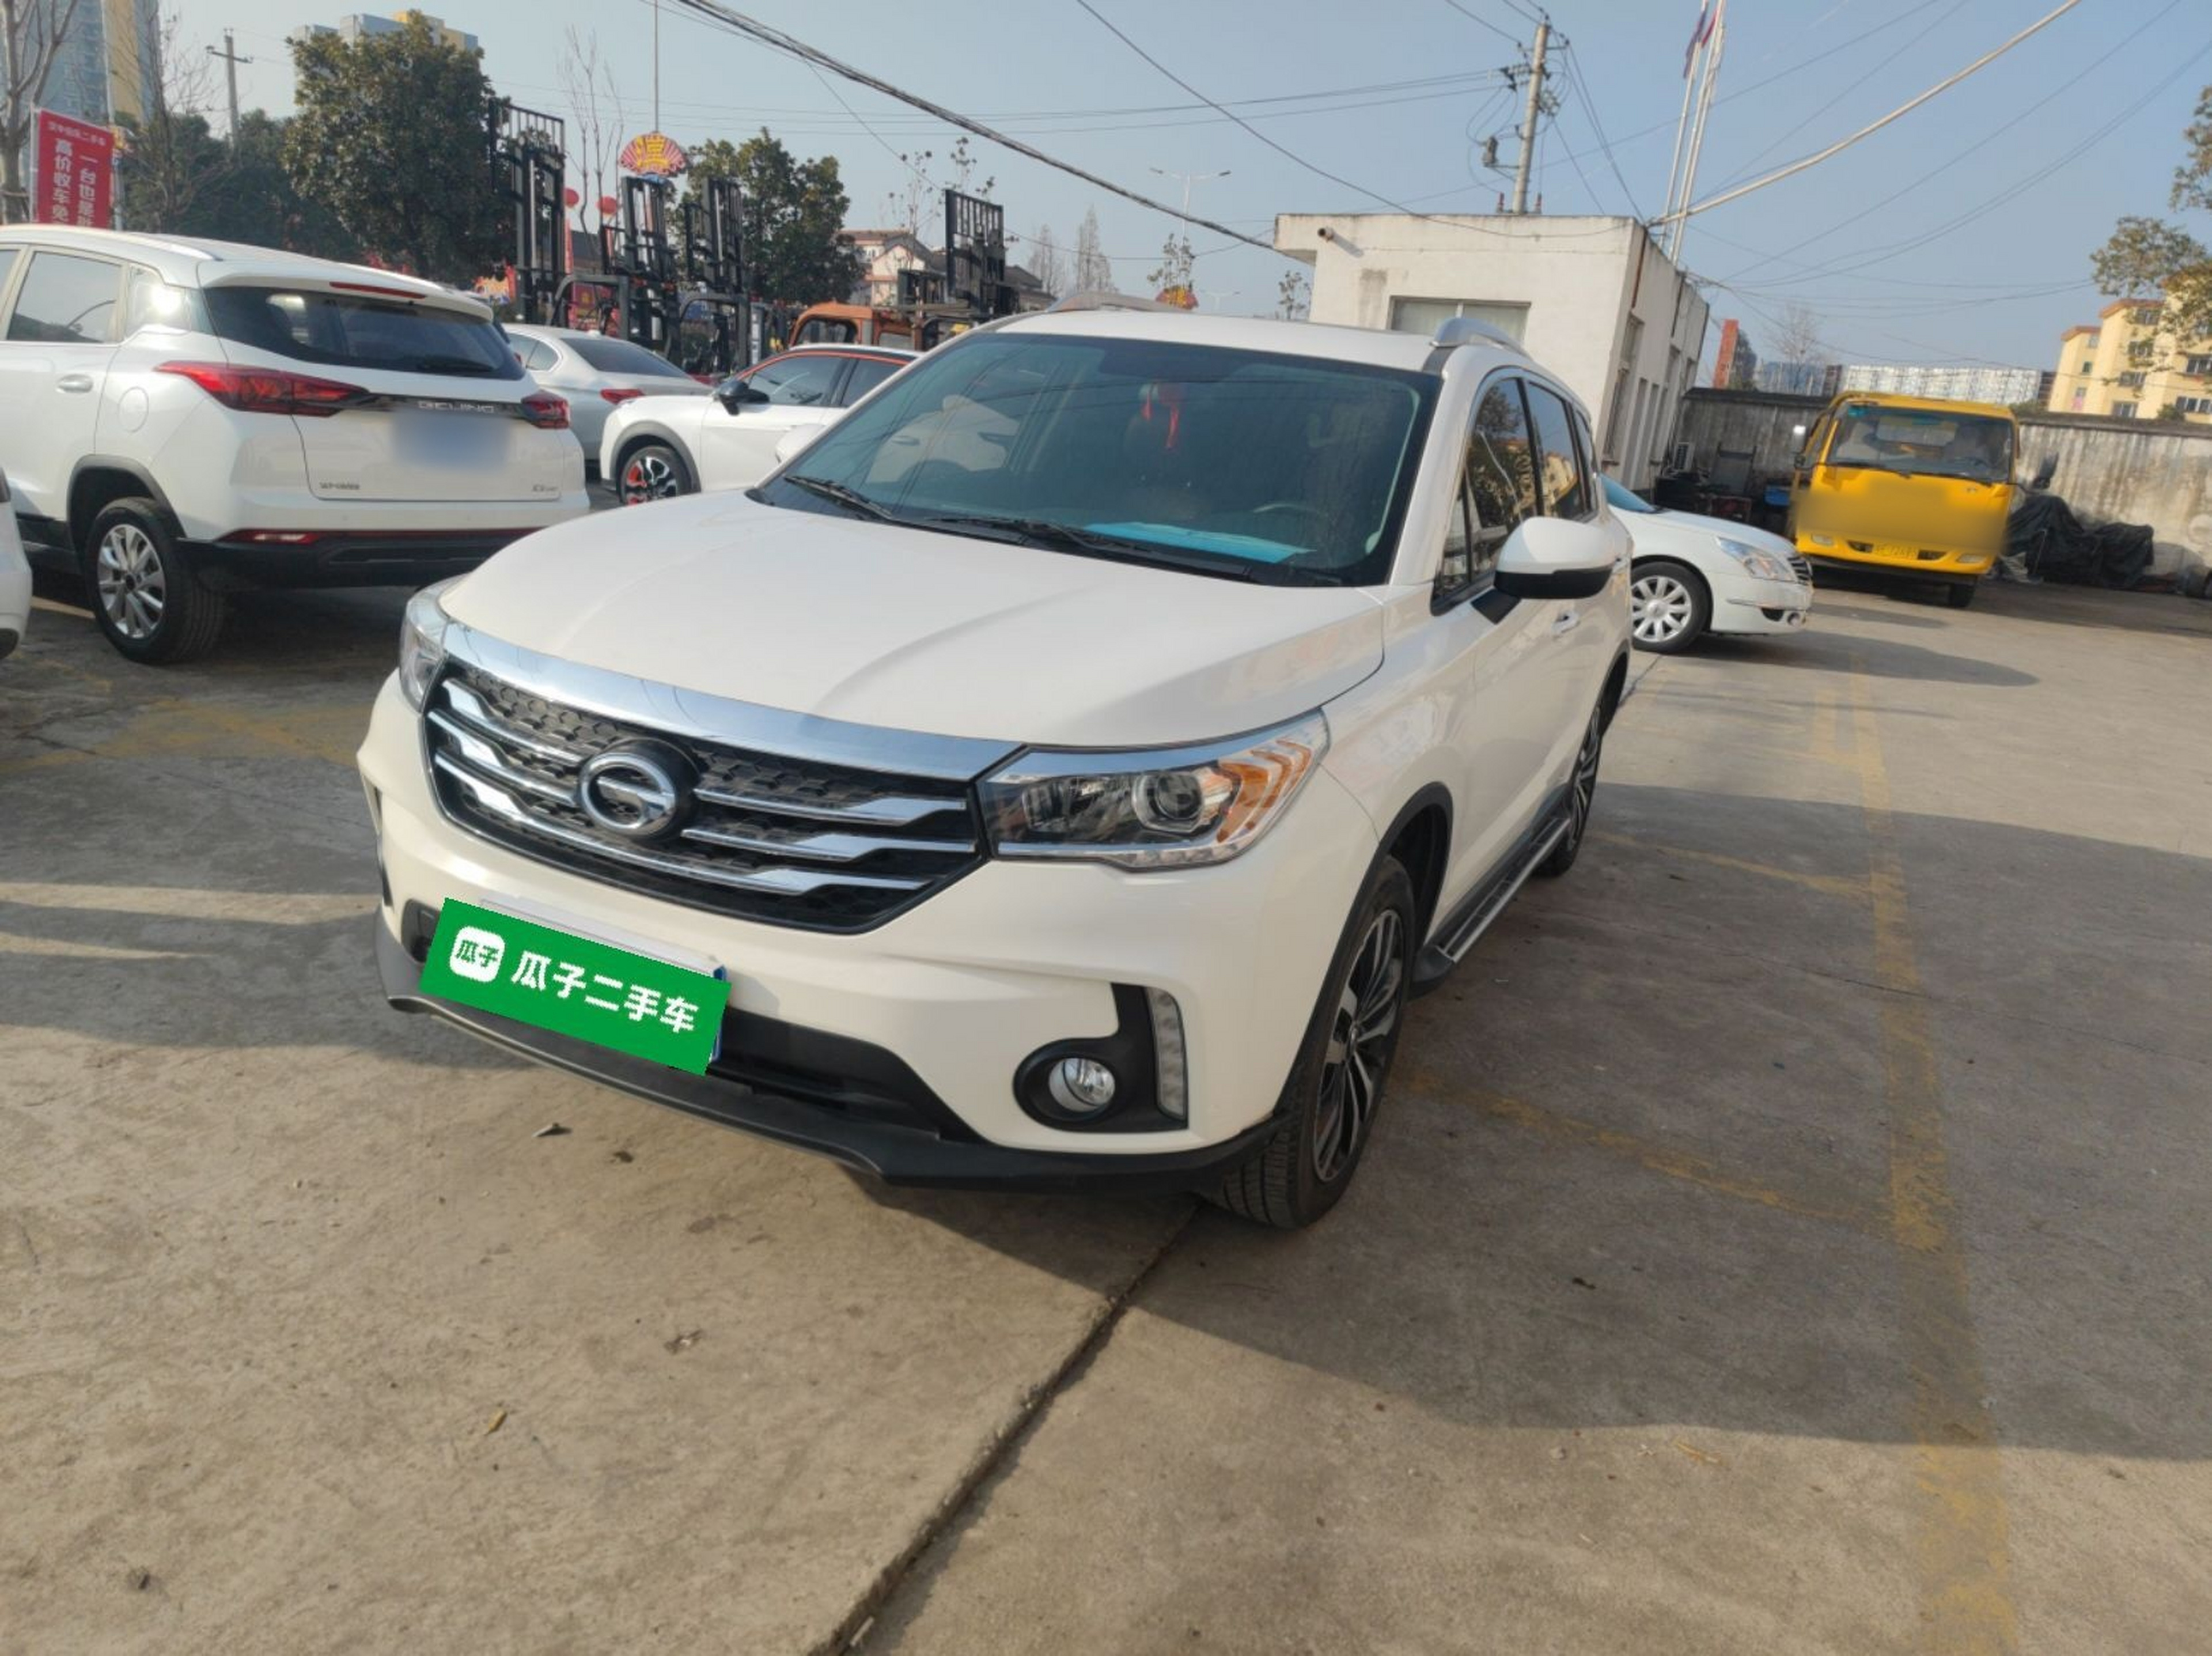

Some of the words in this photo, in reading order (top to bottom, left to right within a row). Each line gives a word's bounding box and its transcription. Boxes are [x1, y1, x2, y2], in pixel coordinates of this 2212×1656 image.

[52, 138, 73, 224] 高价收车免
